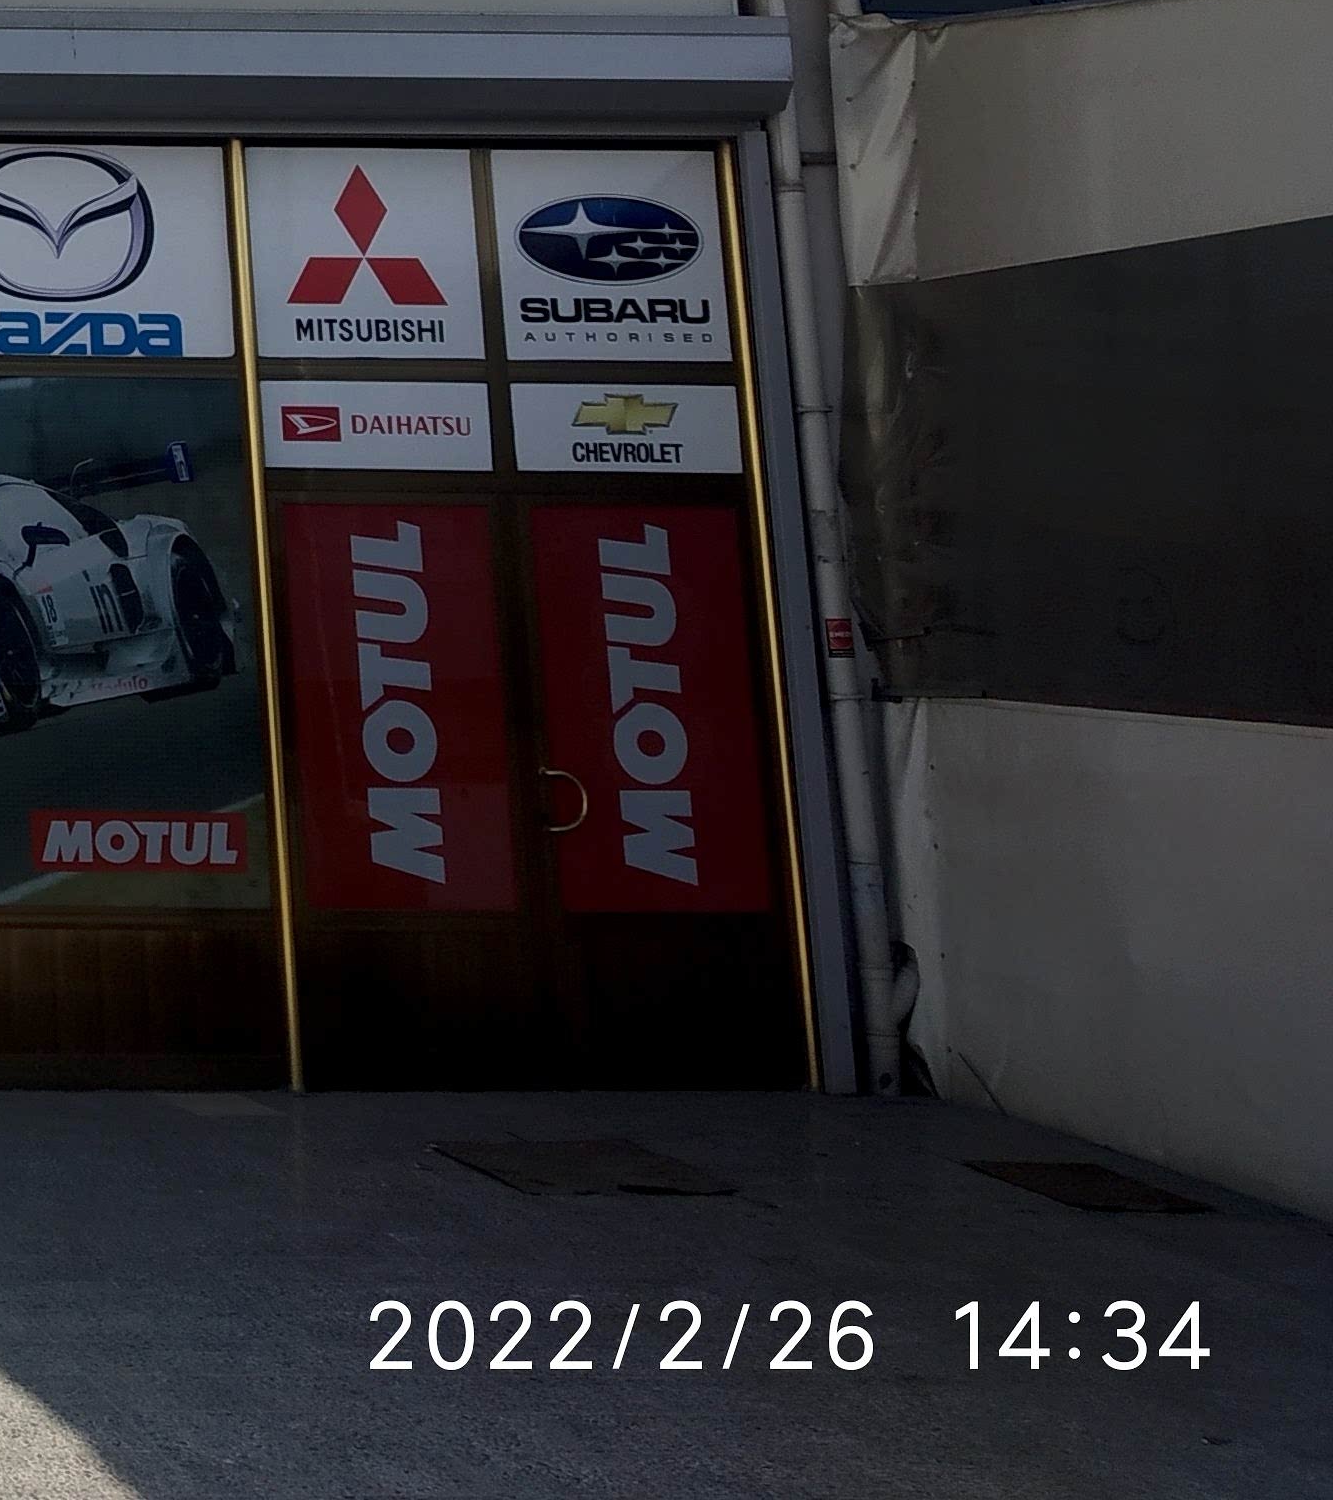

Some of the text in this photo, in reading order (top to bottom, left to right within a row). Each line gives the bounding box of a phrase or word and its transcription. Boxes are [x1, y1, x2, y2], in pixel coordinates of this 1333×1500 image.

[520, 297, 711, 324] SUBARU
[295, 317, 445, 343] MITSUBISHI
[524, 332, 714, 343] AUTHORISED
[351, 414, 472, 437] DAIHATSU
[572, 442, 684, 464] CHEVROLET
[350, 520, 446, 884] MOTUL
[598, 523, 699, 886] MOTUL
[41, 820, 240, 867] MOTUL
